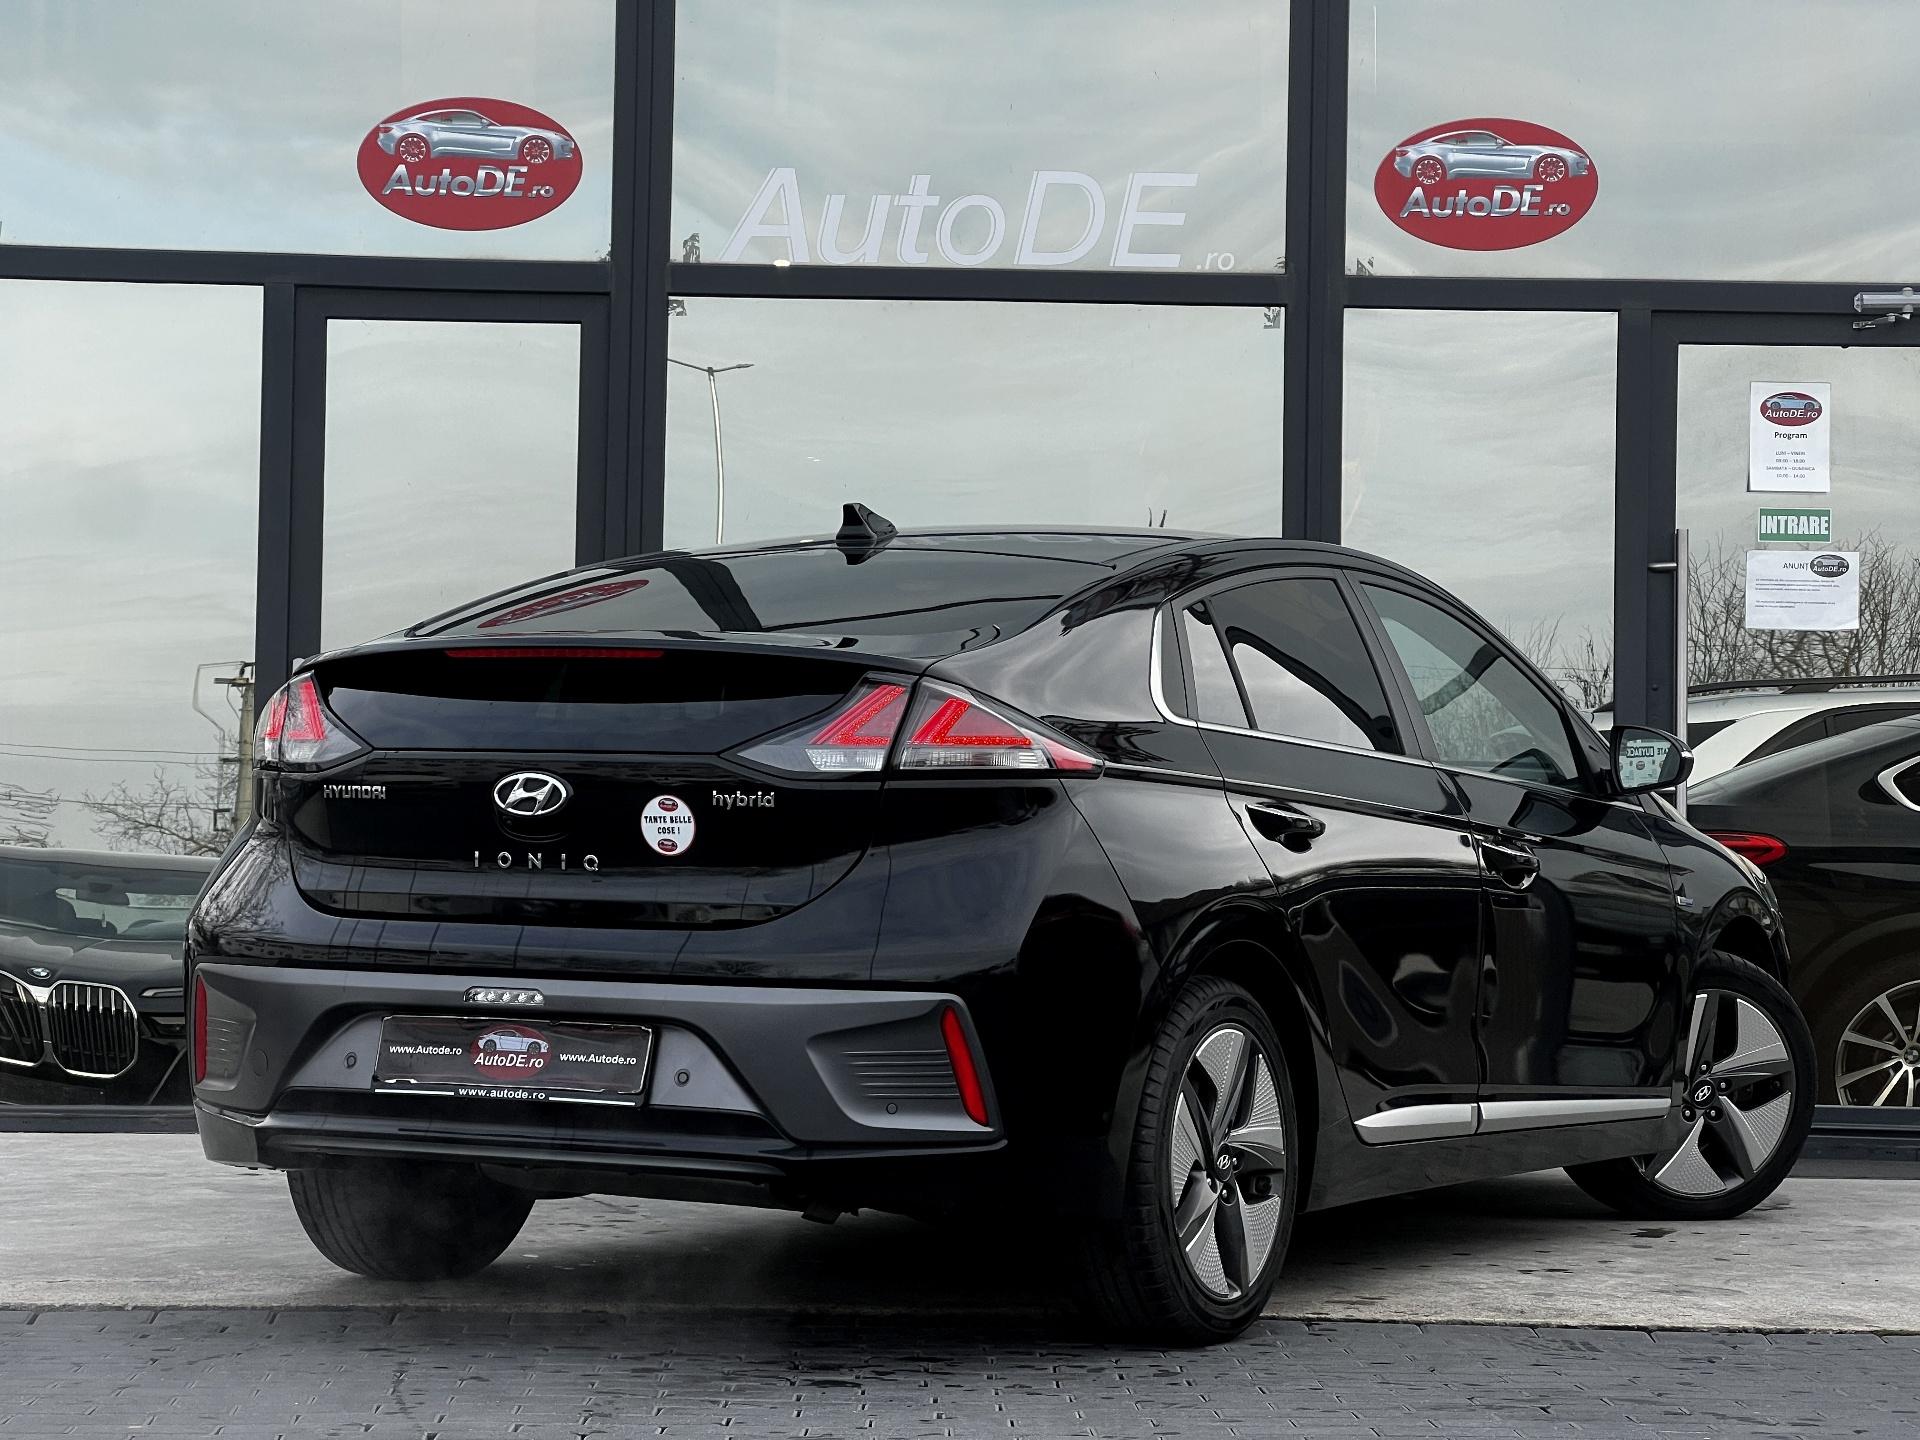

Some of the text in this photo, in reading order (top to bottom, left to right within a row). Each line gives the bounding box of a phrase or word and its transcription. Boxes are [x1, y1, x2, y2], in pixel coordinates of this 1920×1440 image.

[1765, 410, 1818, 418] AutoDE.ro
[1774, 432, 1808, 440] Program
[1760, 515, 1829, 535] INTRARE
[323, 785, 386, 800] HYUNDAI
[712, 790, 775, 810] hybrid
[644, 815, 692, 824] TANTE BELLE
[657, 826, 675, 834] COSE
[474, 850, 599, 871] IONIQ
[389, 1045, 462, 1056] www.Autode.ro
[474, 1052, 544, 1069] AutoDE.ro
[559, 1053, 637, 1065] www.Autode.ro
[458, 1087, 546, 1100] www.autode.ro
